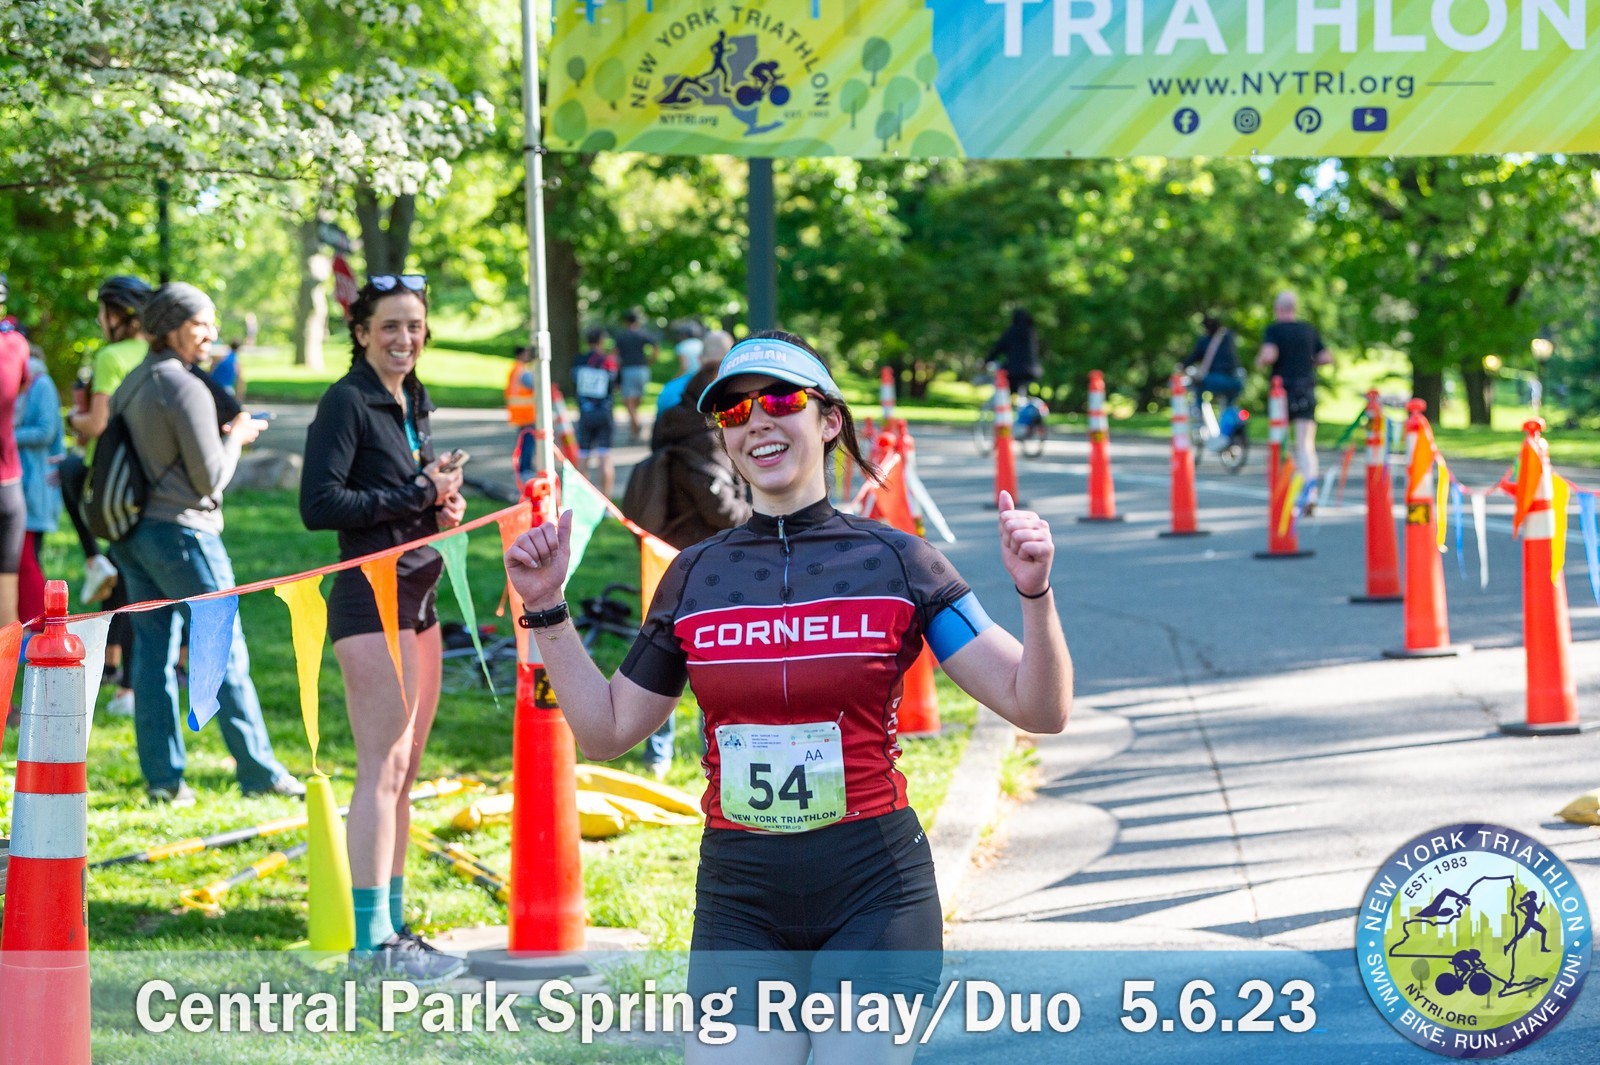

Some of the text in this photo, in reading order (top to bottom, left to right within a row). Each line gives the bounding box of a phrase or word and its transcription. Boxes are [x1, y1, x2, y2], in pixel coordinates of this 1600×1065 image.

[985, 0, 1587, 57] TRIATHLON
[630, 5, 830, 109] NEW YORK TRIATHLON
[1147, 71, 1415, 98] www.NYTRI.org
[693, 613, 887, 649] CORNELL
[804, 748, 824, 762] AA
[747, 762, 814, 811] 54
[731, 810, 837, 824] NEW YORK TRIATHLON
